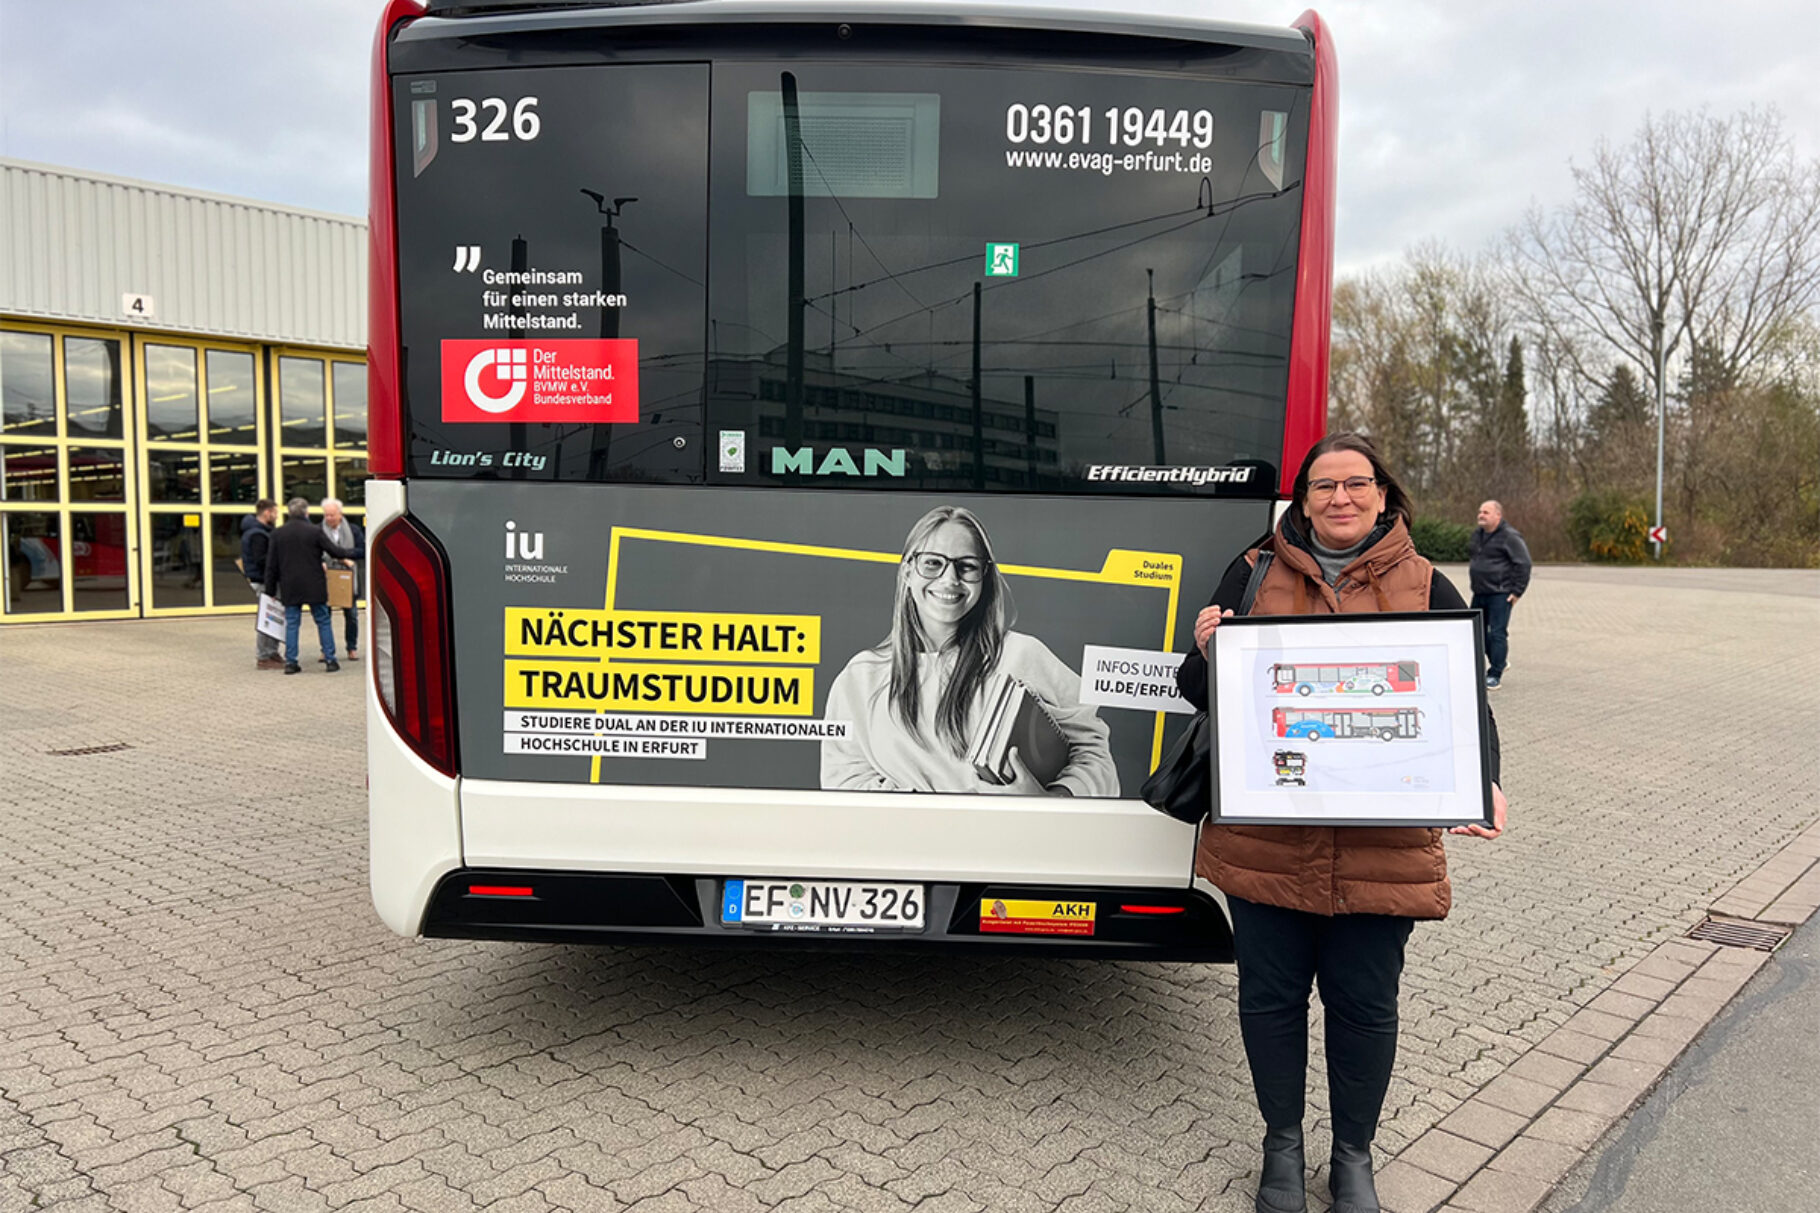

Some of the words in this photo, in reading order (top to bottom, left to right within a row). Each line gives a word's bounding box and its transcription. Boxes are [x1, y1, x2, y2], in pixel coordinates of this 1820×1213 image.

[451, 96, 541, 143] 326
[1006, 103, 1091, 145] 0361
[1105, 106, 1214, 149] 19449
[1006, 150, 1213, 175] www.evag-erfurt.de
[482, 268, 583, 285] Gemeinsam
[132, 297, 144, 313] 4
[482, 291, 507, 307] für
[512, 291, 558, 307] einen
[562, 291, 627, 307] starken
[483, 313, 582, 329] Mittelstand.
[533, 348, 557, 363] Der
[533, 364, 615, 380] Mittelstand.
[533, 381, 568, 392] BVMW
[533, 392, 612, 405] Bundesverband
[502, 451, 547, 471] City
[772, 447, 905, 477] MAN
[1087, 465, 1251, 486] EfficientHybrid
[505, 520, 543, 560] iu
[505, 564, 568, 574] INTERNATIONALE
[1143, 560, 1173, 571] Duales
[505, 574, 556, 583] HOCHSCHULE
[1134, 570, 1173, 581] Studium
[520, 611, 703, 650] NÄCHSTER
[712, 623, 806, 654] HALT:
[1097, 660, 1140, 676] INFOS
[1142, 663, 1180, 679] UNTE
[519, 670, 801, 705] TRAUMSTUDIUM
[1094, 679, 1182, 699] IU.DE/ERFU
[520, 715, 592, 730] STUDIERE
[594, 718, 633, 731] DUAL
[635, 720, 656, 732] AN
[659, 721, 689, 733] DER
[692, 721, 707, 733] IU
[710, 721, 846, 737] INTERNATIONALEN
[520, 737, 620, 753] HOCHSCHULE
[623, 741, 638, 753] IN
[642, 741, 699, 755] ERFURT
[728, 903, 738, 914] D
[745, 885, 787, 917] EF
[810, 886, 852, 918] NV
[860, 888, 919, 920] 326
[1052, 903, 1090, 917] AKH
